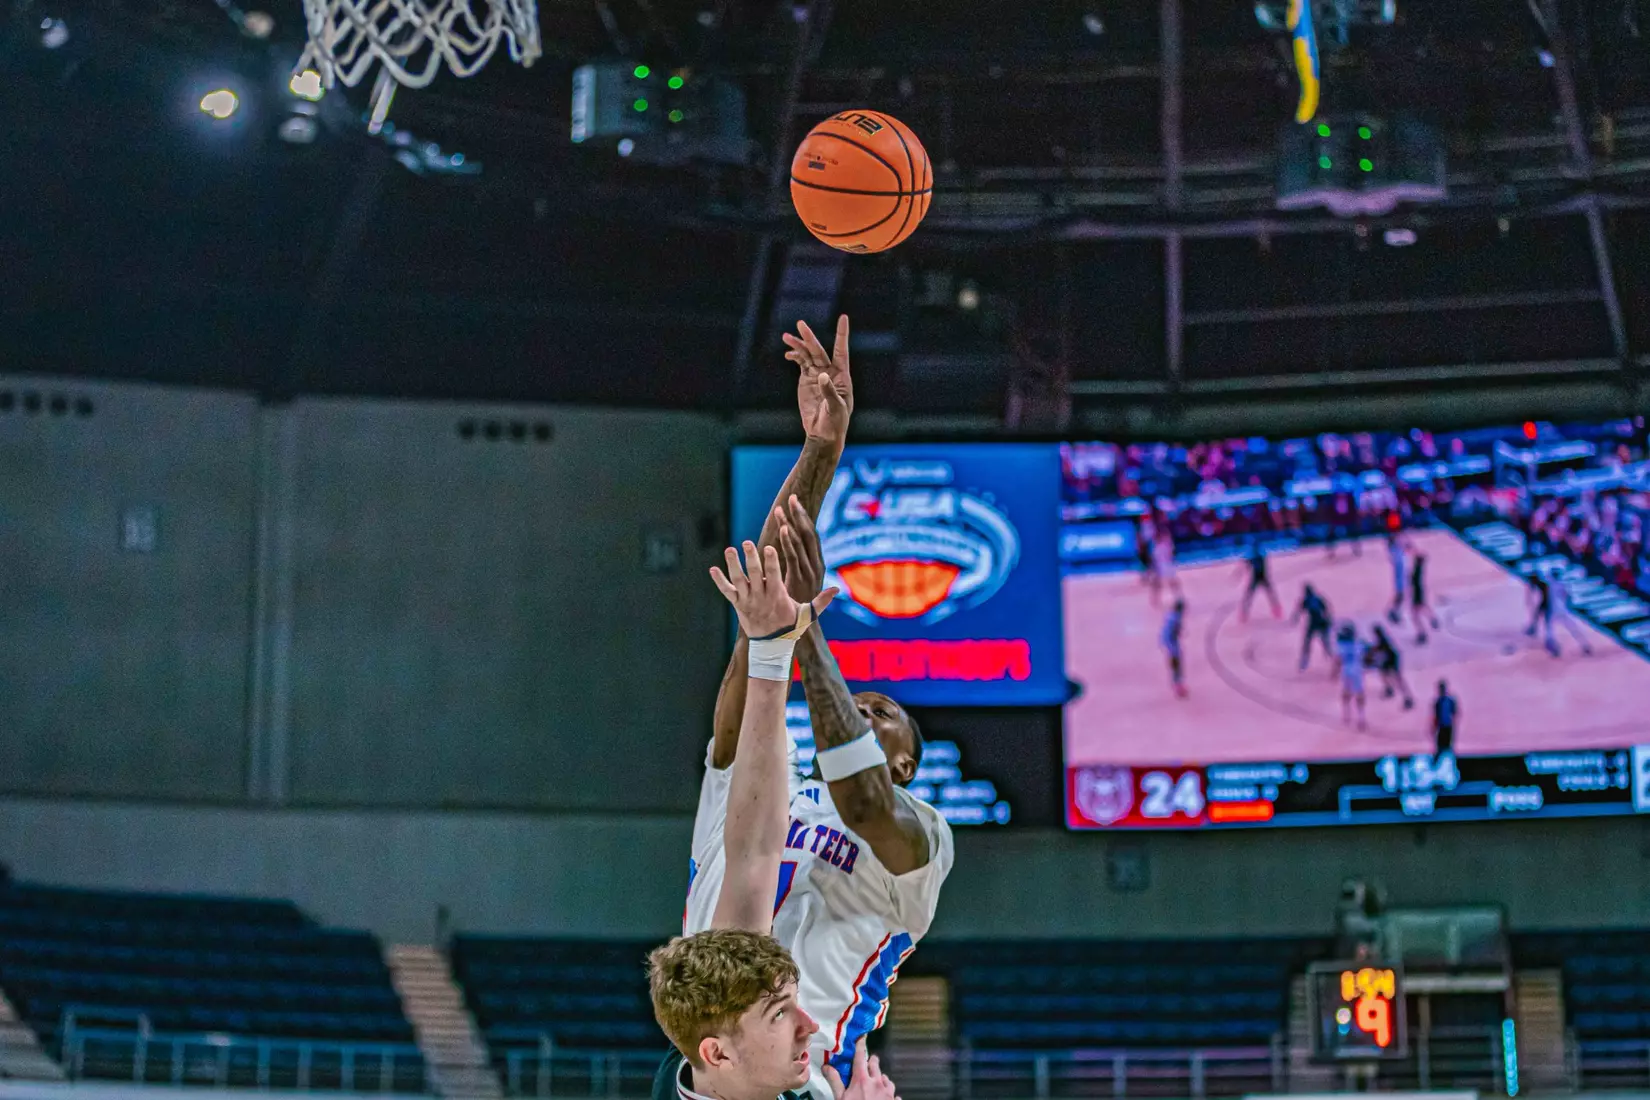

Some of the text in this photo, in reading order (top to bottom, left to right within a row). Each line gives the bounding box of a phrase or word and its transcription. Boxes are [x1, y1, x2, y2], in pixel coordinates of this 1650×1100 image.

[1140, 771, 1205, 818] 24
[810, 824, 859, 875] TECH
[1356, 998, 1391, 1047] 9
